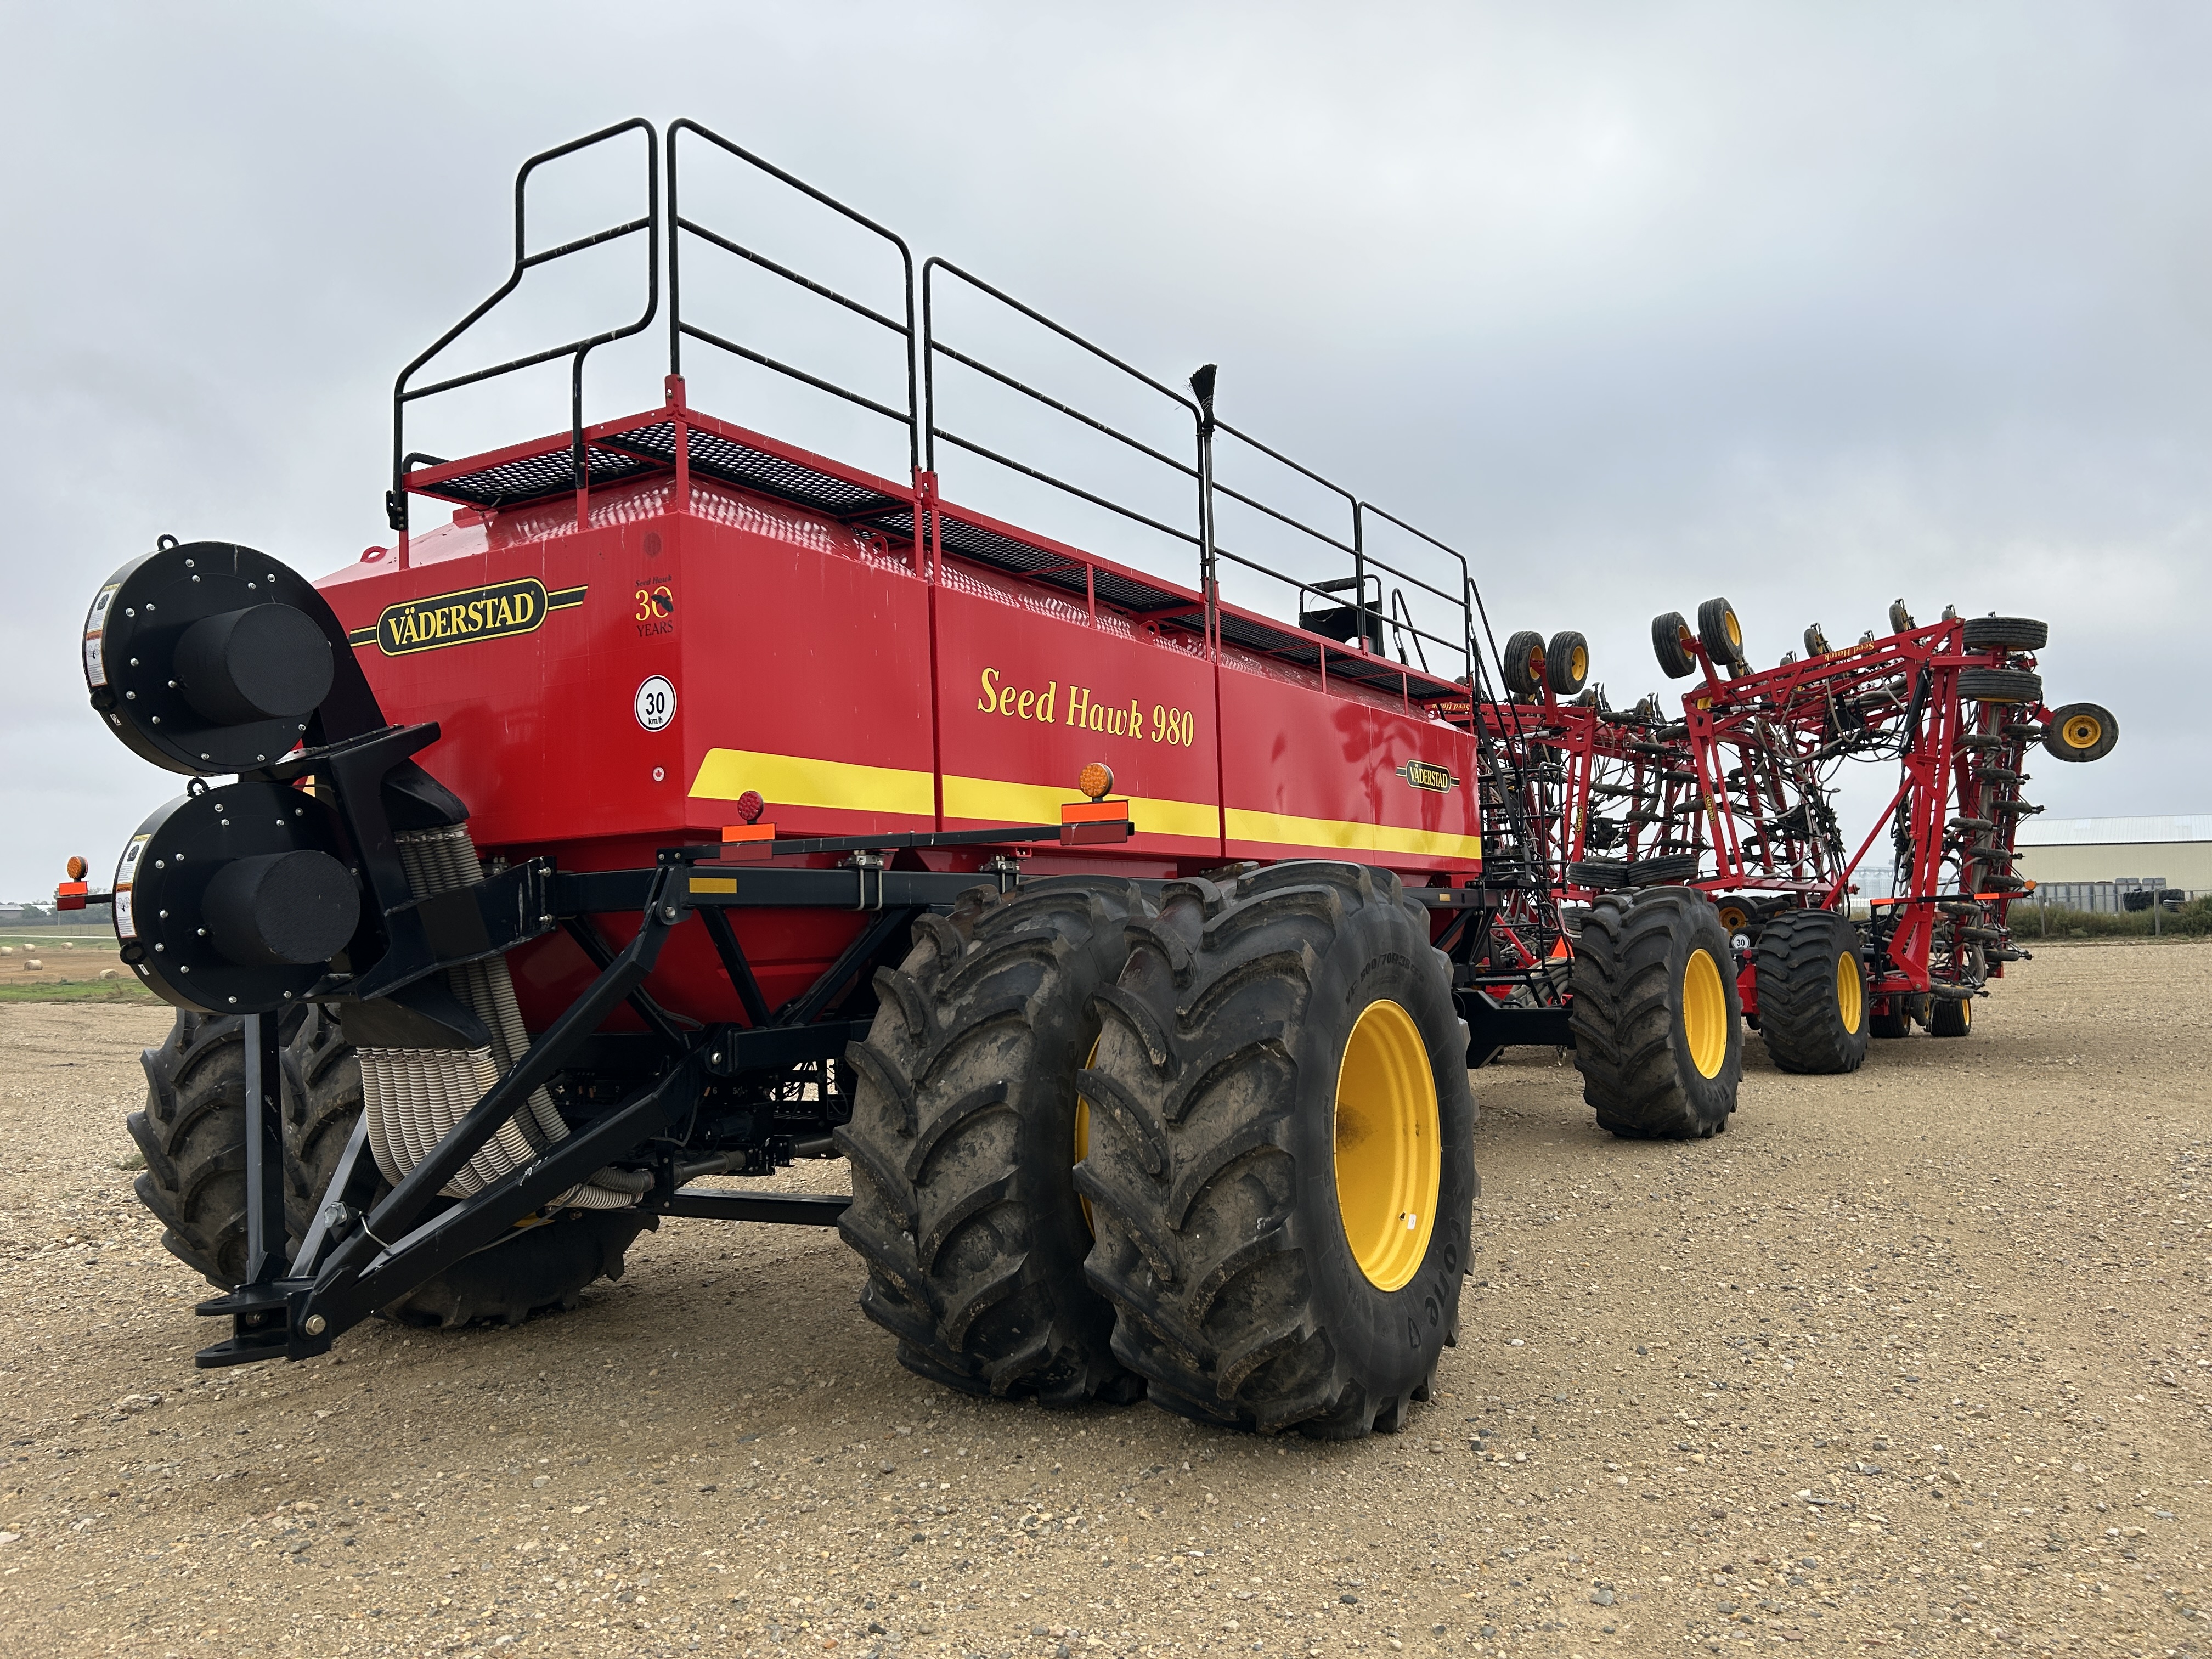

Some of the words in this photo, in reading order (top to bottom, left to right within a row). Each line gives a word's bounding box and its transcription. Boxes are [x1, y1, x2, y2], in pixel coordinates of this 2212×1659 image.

[635, 586, 674, 622] 30
[636, 620, 674, 637] YEARS
[646, 691, 665, 715] 30
[977, 667, 1057, 723] Seed
[1066, 685, 1143, 740] Hawk
[1151, 704, 1194, 748] 980
[648, 716, 663, 725] km/h
[1409, 764, 1448, 788] VÄDERSTAD
